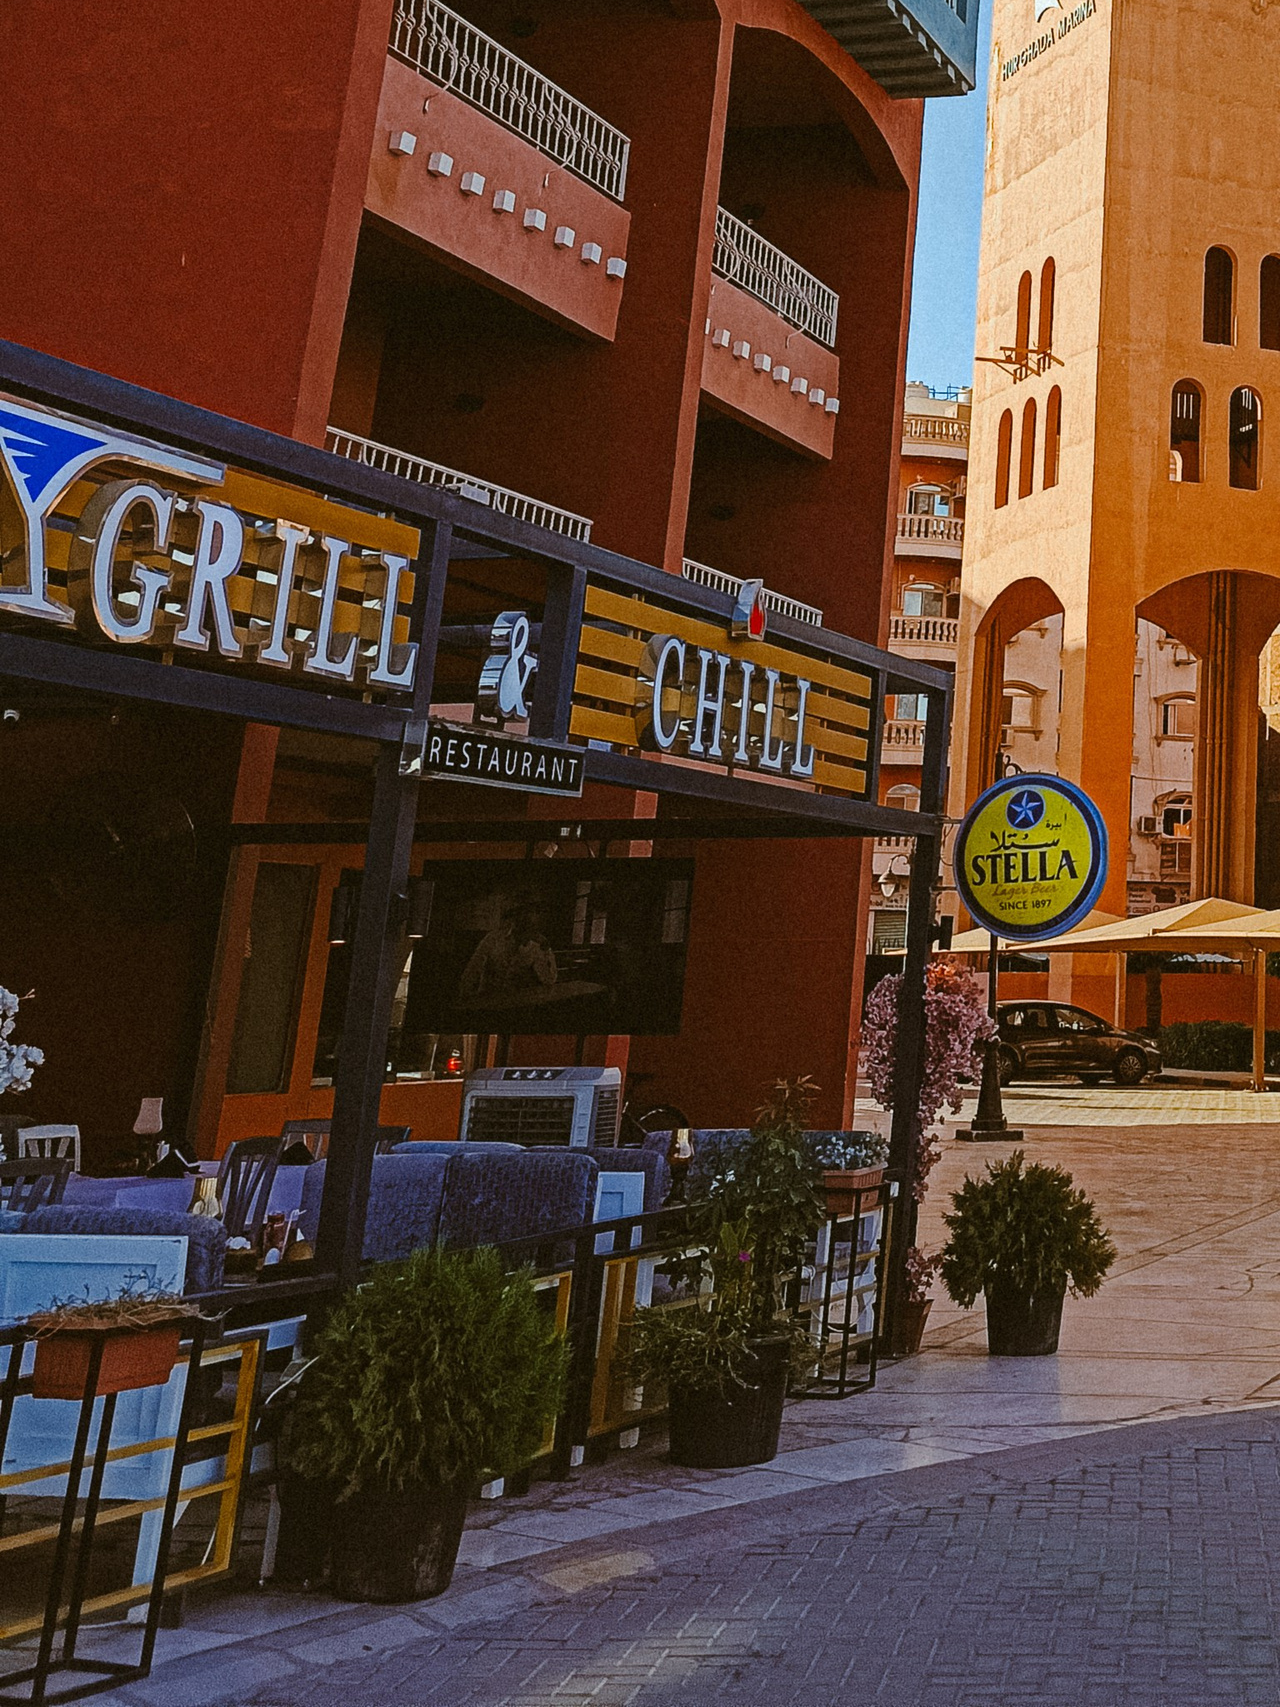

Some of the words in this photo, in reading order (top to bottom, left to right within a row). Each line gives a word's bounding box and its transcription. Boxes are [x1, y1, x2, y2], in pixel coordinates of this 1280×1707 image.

[90, 479, 420, 692] GRILL
[498, 614, 538, 719] &
[652, 637, 815, 776] CHILL
[429, 736, 578, 783] RESTAURANT
[972, 850, 1078, 886] STELLA
[992, 883, 1027, 900] Lager
[1030, 882, 1058, 895] Beer
[999, 900, 1028, 911] SINCE
[1032, 899, 1051, 909] 1897
